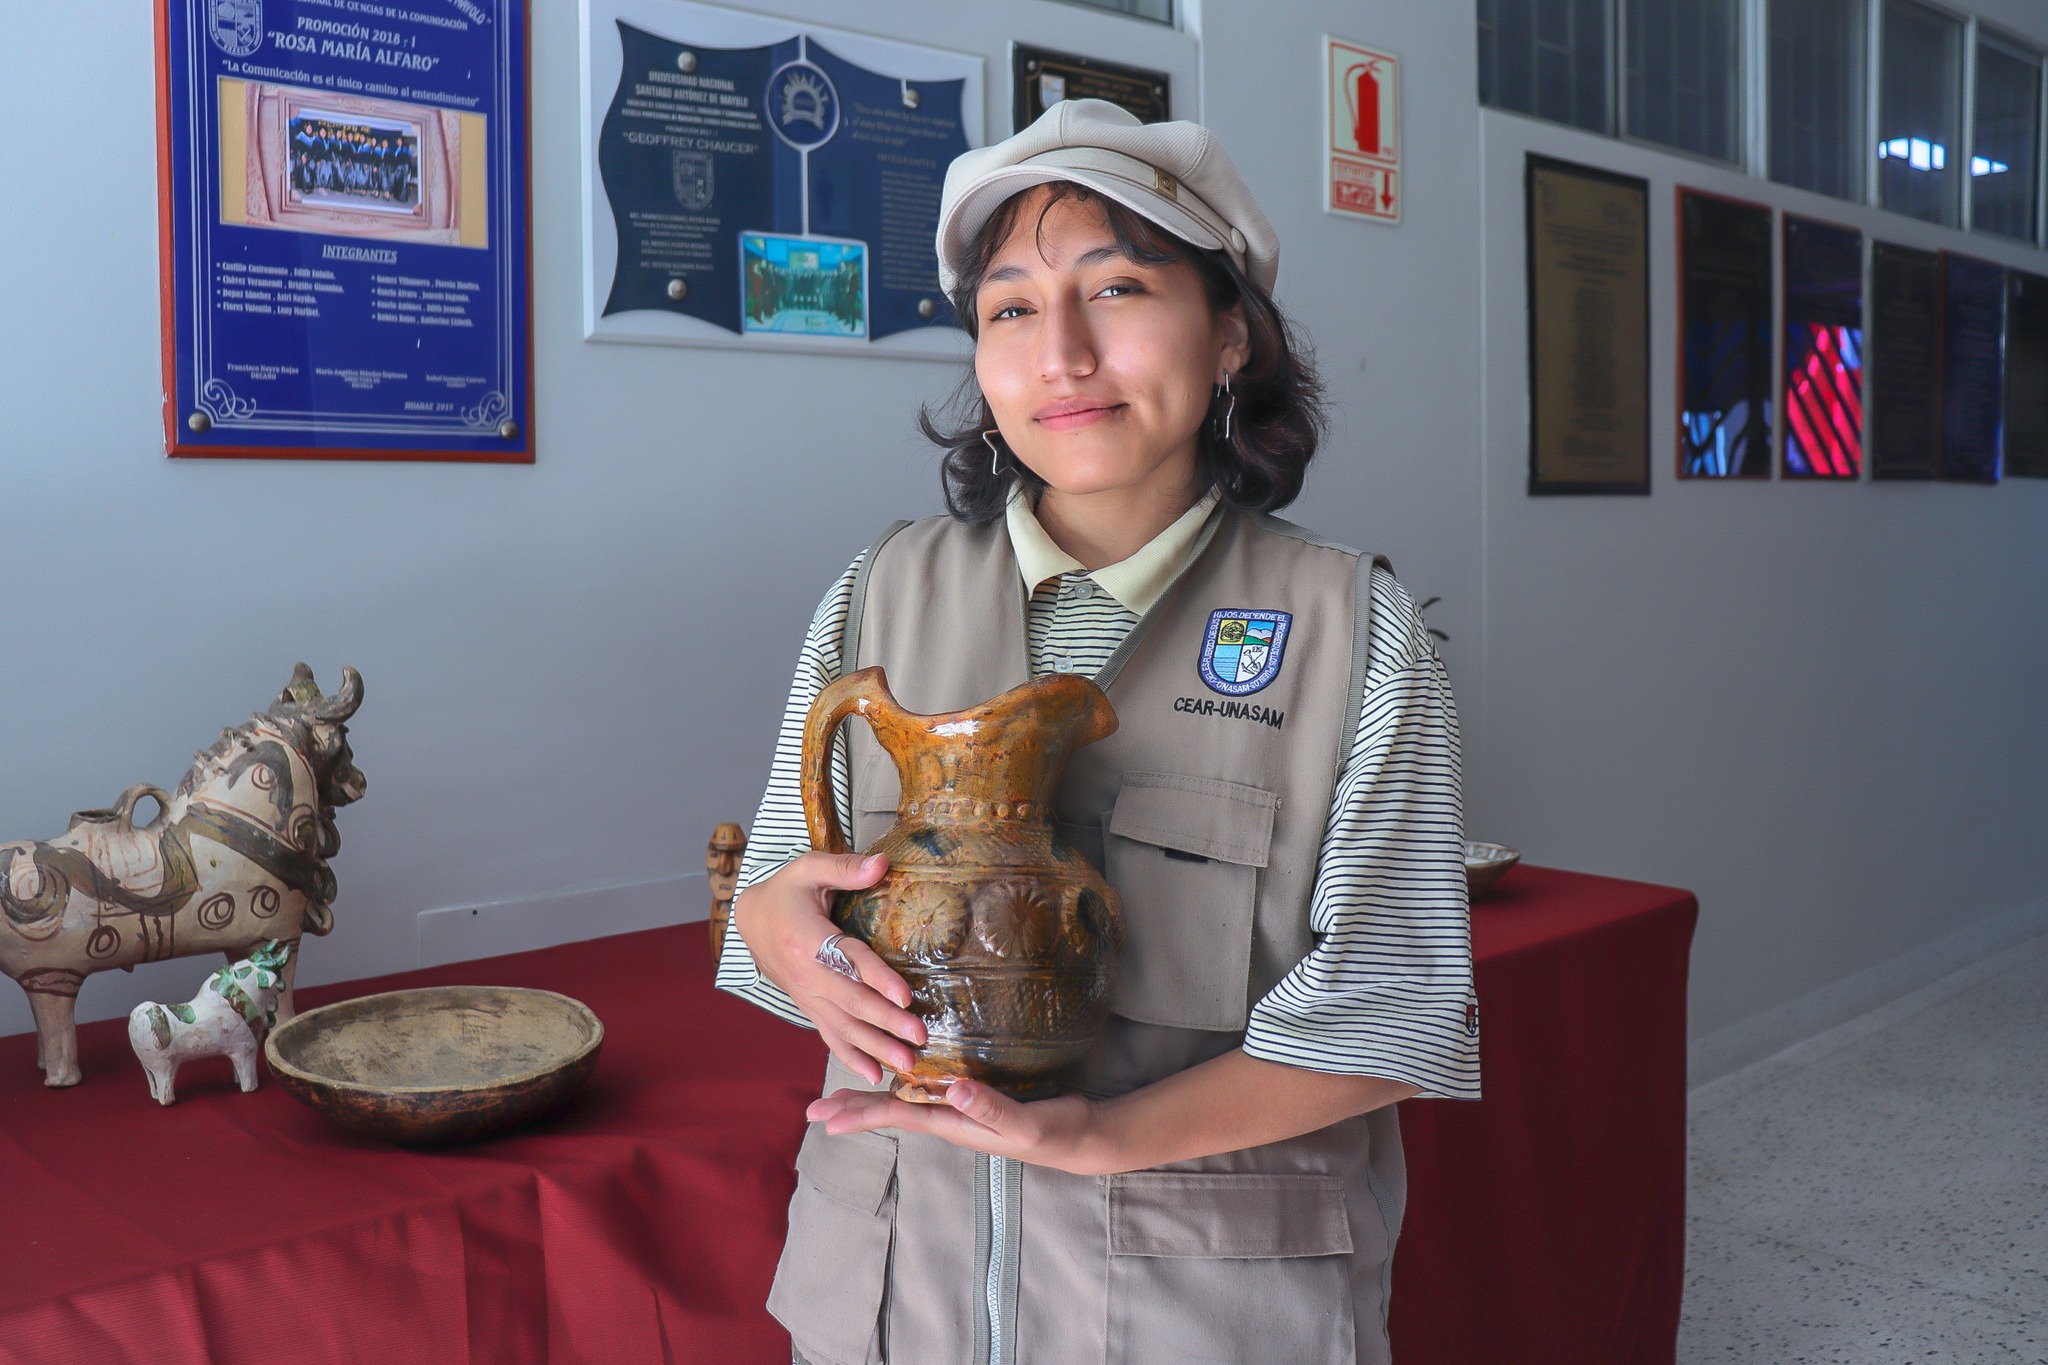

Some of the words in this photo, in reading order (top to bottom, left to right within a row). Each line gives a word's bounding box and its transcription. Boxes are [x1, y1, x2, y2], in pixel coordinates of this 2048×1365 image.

[346, 1, 383, 15] CIENCIAS
[385, 7, 397, 18] DE
[398, 10, 409, 20] LA
[409, 11, 468, 31] COMUNICACIÓN
[297, 16, 370, 40] PROMOCIÓN
[371, 29, 401, 45] 2018
[320, 40, 372, 62] MARÍA
[241, 62, 310, 82] Comunicación
[312, 74, 323, 85] es
[325, 74, 335, 86] el
[337, 75, 363, 89] único
[365, 82, 399, 95] camino
[401, 86, 410, 98] al
[648, 70, 698, 87] UNIVERSIDAD
[699, 77, 735, 92] NACIONAL
[635, 83, 673, 99] SANTIAGO
[709, 93, 719, 104] DE
[719, 95, 749, 108] MAYOLO
[322, 244, 397, 263] INTEGRANTES
[227, 363, 260, 373] Francisco
[280, 366, 299, 375] Rojas
[404, 401, 434, 412] HUARAZ
[436, 403, 454, 412] 2019
[1213, 611, 1238, 619] HIJOS
[1173, 697, 1285, 730] CEAR-UNASAM
